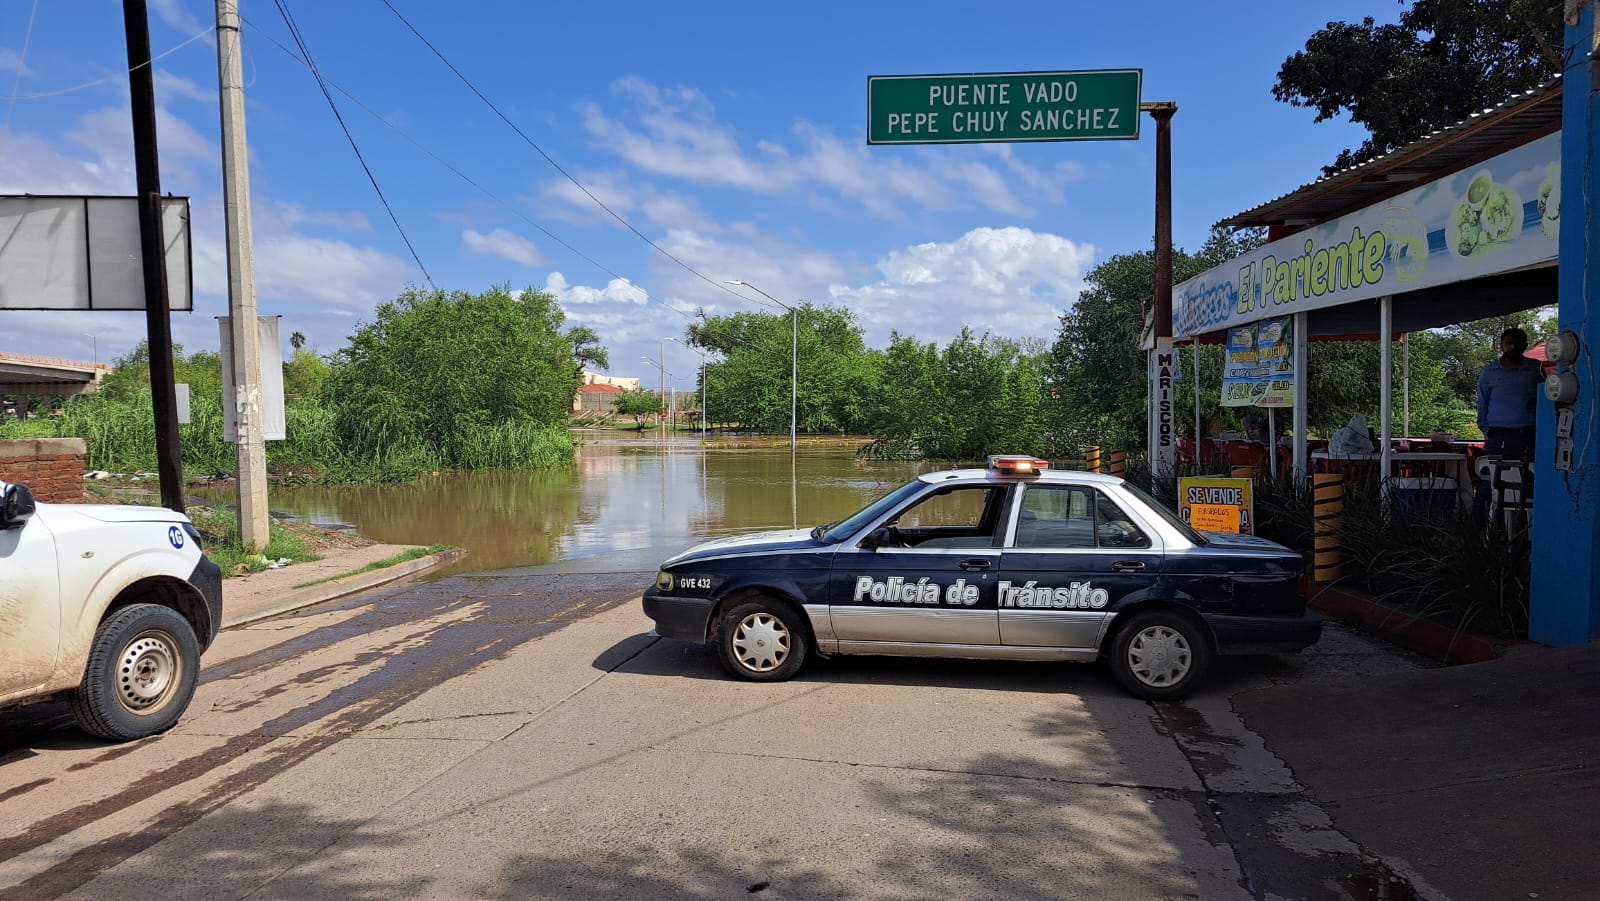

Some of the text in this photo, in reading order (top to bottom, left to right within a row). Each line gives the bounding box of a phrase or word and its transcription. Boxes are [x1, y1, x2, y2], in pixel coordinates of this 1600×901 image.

[929, 81, 1078, 106] PUENTE VADO
[888, 108, 1120, 134] PEPE CHUY SANCHEZ
[1237, 261, 1256, 315] El
[1260, 227, 1386, 309] Pariente
[1158, 353, 1172, 446] MARISCOS
[1188, 487, 1242, 505] SE VENDE
[169, 529, 183, 545] 1G
[680, 578, 711, 589] GVE 432
[853, 575, 1109, 608] Policía de Tránsito
